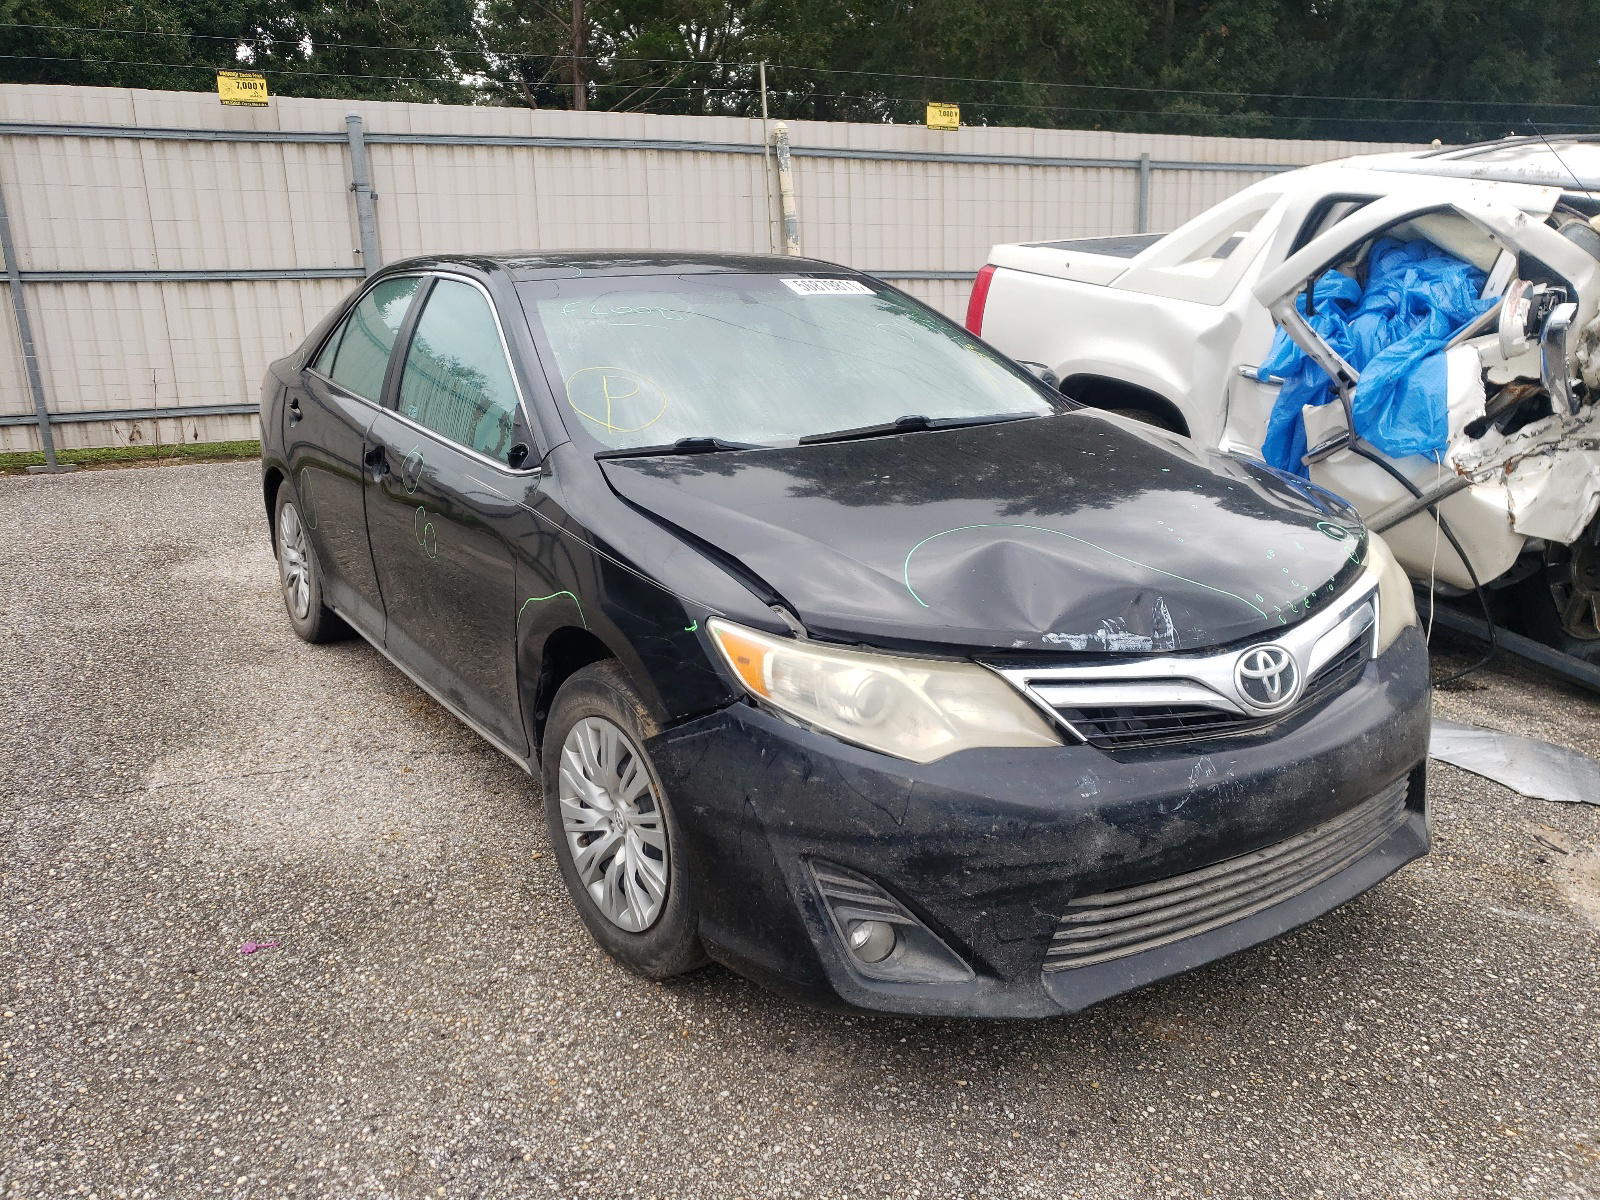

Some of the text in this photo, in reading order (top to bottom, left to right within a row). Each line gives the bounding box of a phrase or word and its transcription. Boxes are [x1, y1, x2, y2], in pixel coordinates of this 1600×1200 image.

[236, 82, 264, 90] 7,000 V
[602, 376, 640, 435] P
